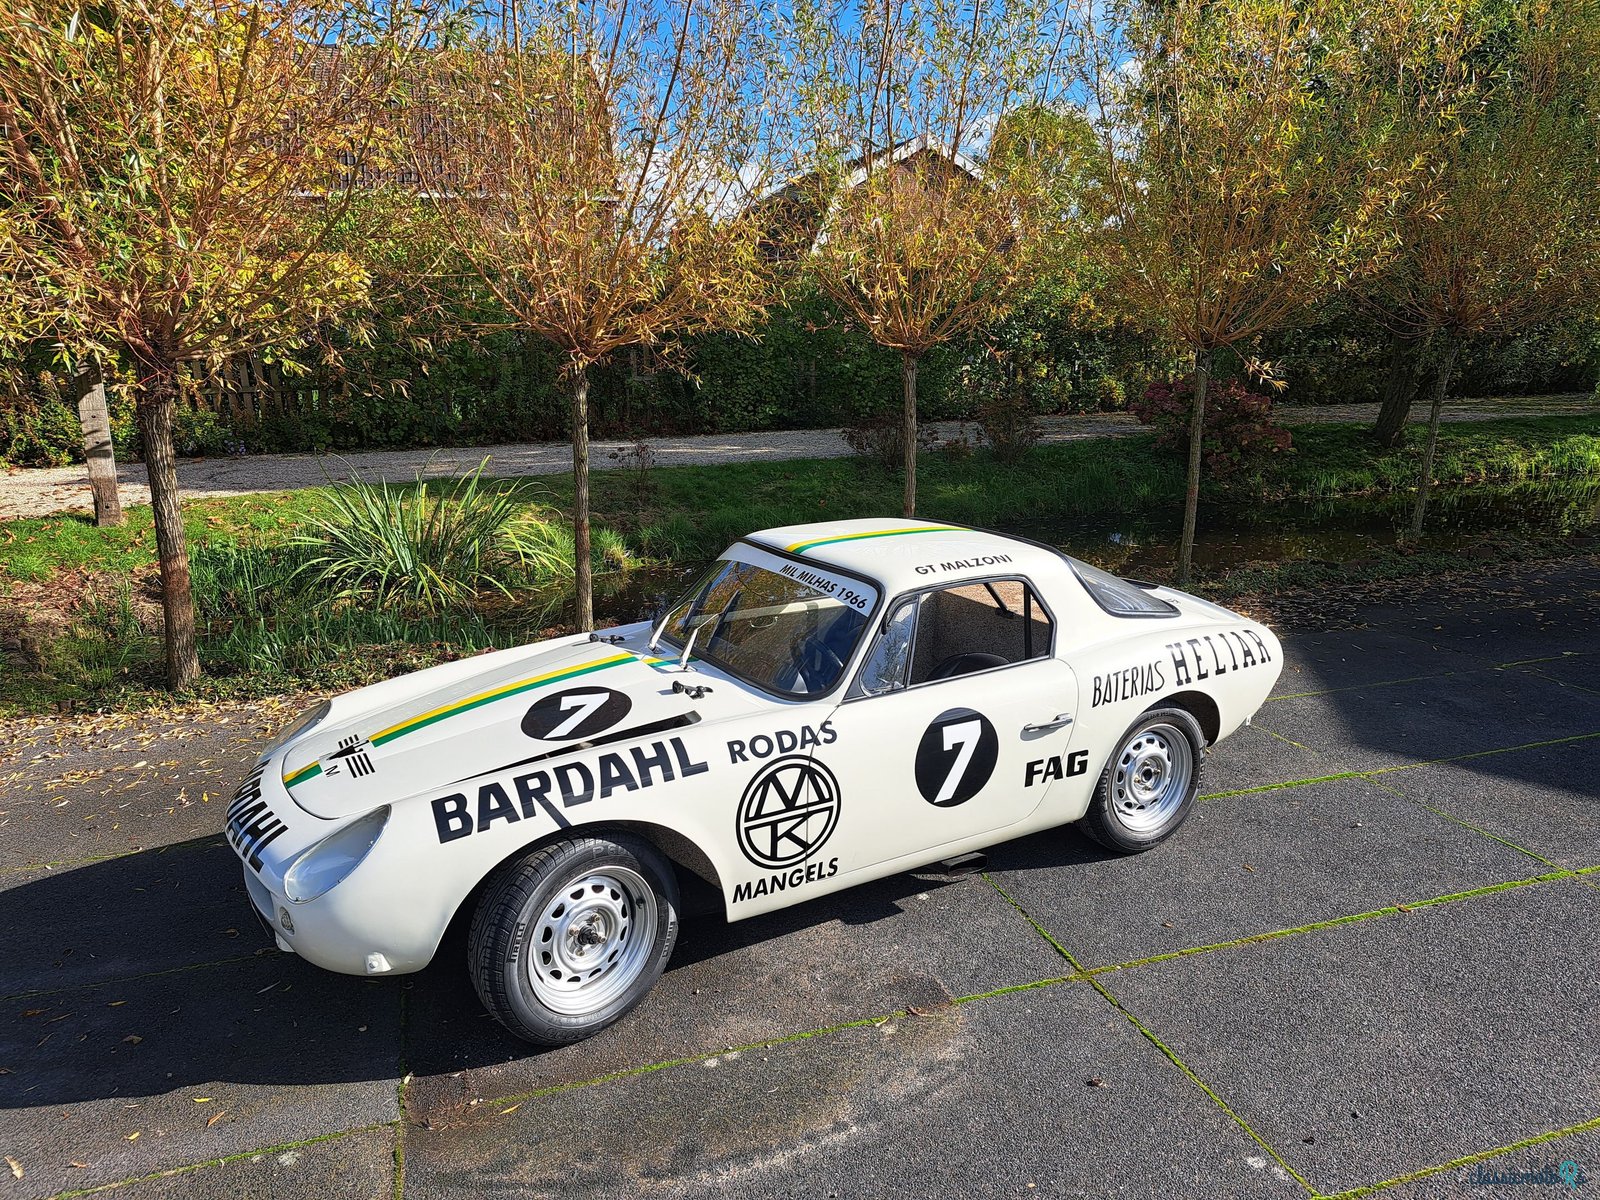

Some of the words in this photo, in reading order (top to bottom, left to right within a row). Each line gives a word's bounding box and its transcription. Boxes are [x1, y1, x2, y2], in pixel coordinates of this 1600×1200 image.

[779, 564, 799, 578] MIL
[796, 570, 838, 593] MILHAS
[837, 587, 868, 609] 1966
[914, 564, 936, 575] GT
[940, 554, 1018, 572] MALZONI
[1092, 660, 1165, 708] BATERIAS
[1165, 629, 1272, 687] HELIAR
[543, 692, 610, 740] 7
[726, 720, 838, 764] RODAS
[933, 719, 982, 803] 7
[431, 736, 710, 843] BARDAHL
[1024, 749, 1089, 788] FAG
[732, 857, 839, 904] MANGELS
